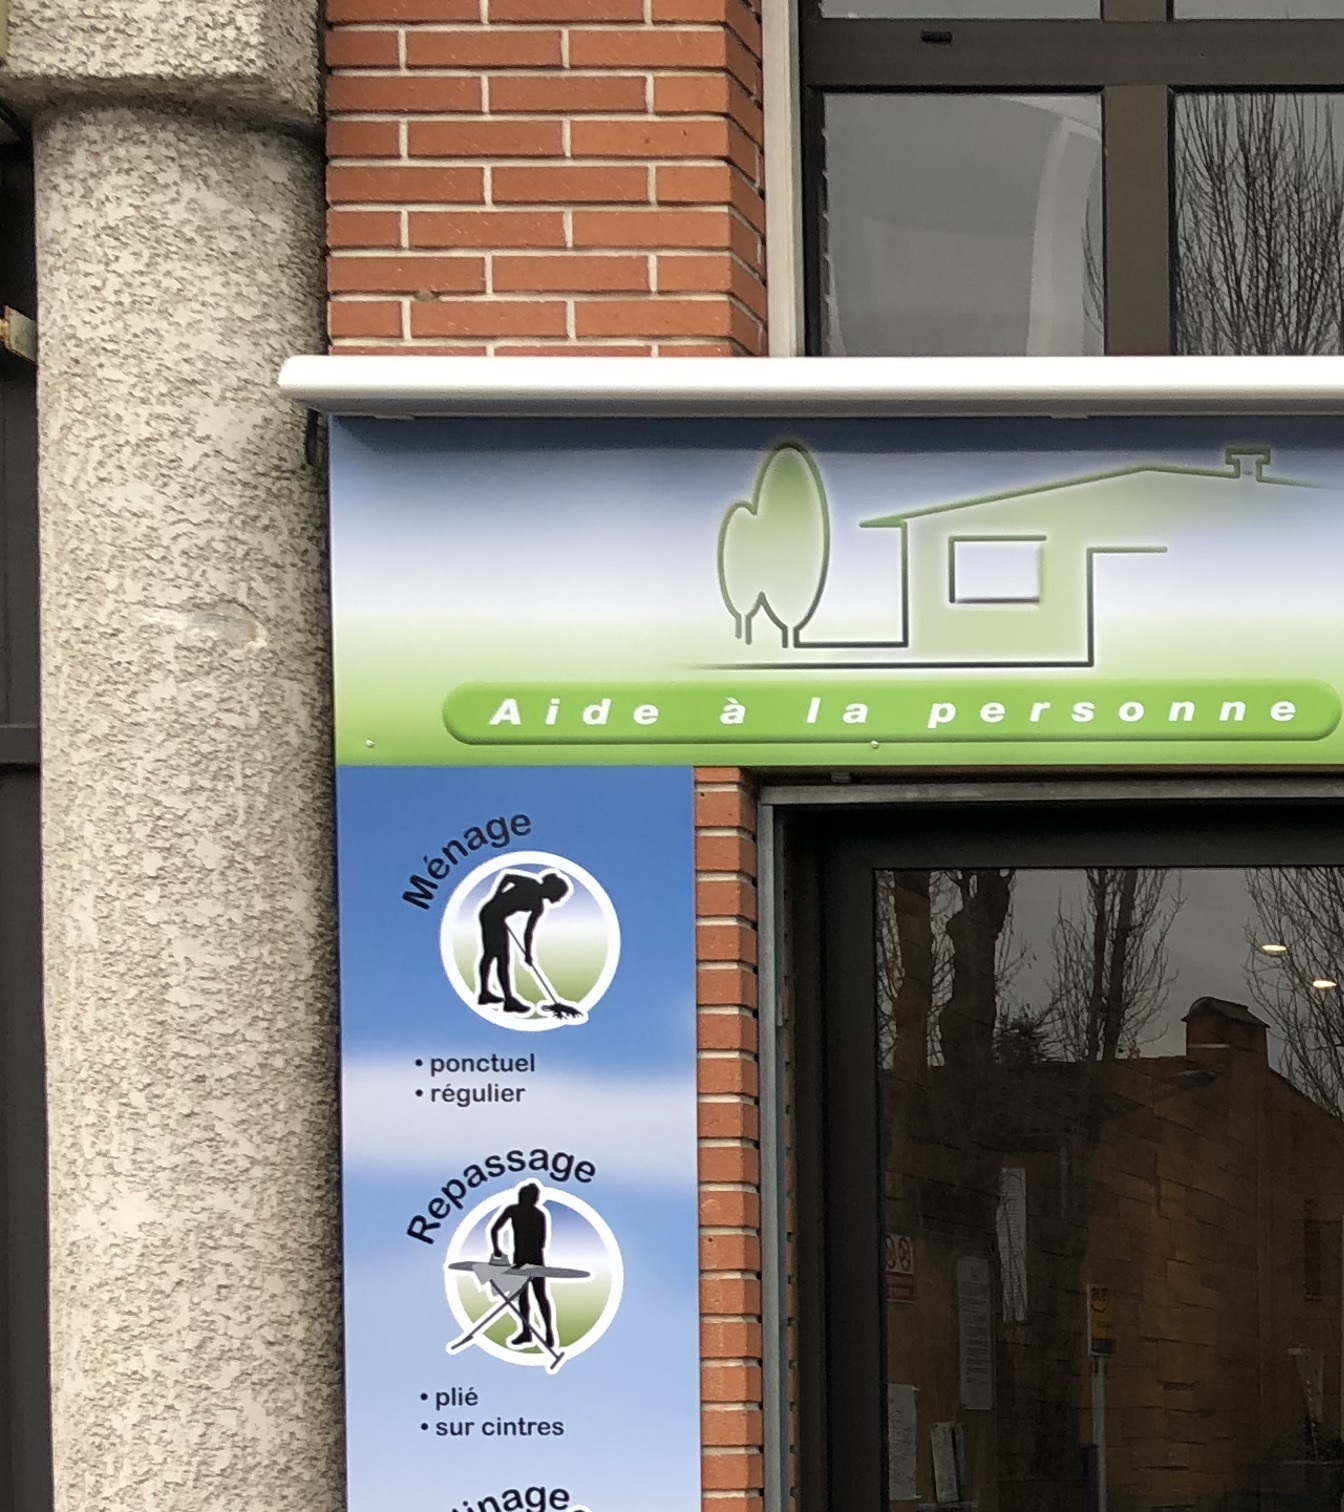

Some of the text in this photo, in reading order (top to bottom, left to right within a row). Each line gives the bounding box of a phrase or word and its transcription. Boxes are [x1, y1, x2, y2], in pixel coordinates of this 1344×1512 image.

[489, 697, 1298, 729] Aide à la personne
[402, 813, 532, 910] Ménage
[430, 1053, 536, 1077] ponctuel
[430, 1083, 527, 1107] régulier
[406, 1148, 597, 1245] Repassage
[435, 1386, 479, 1411] plié
[435, 1416, 565, 1437] sur cintres
